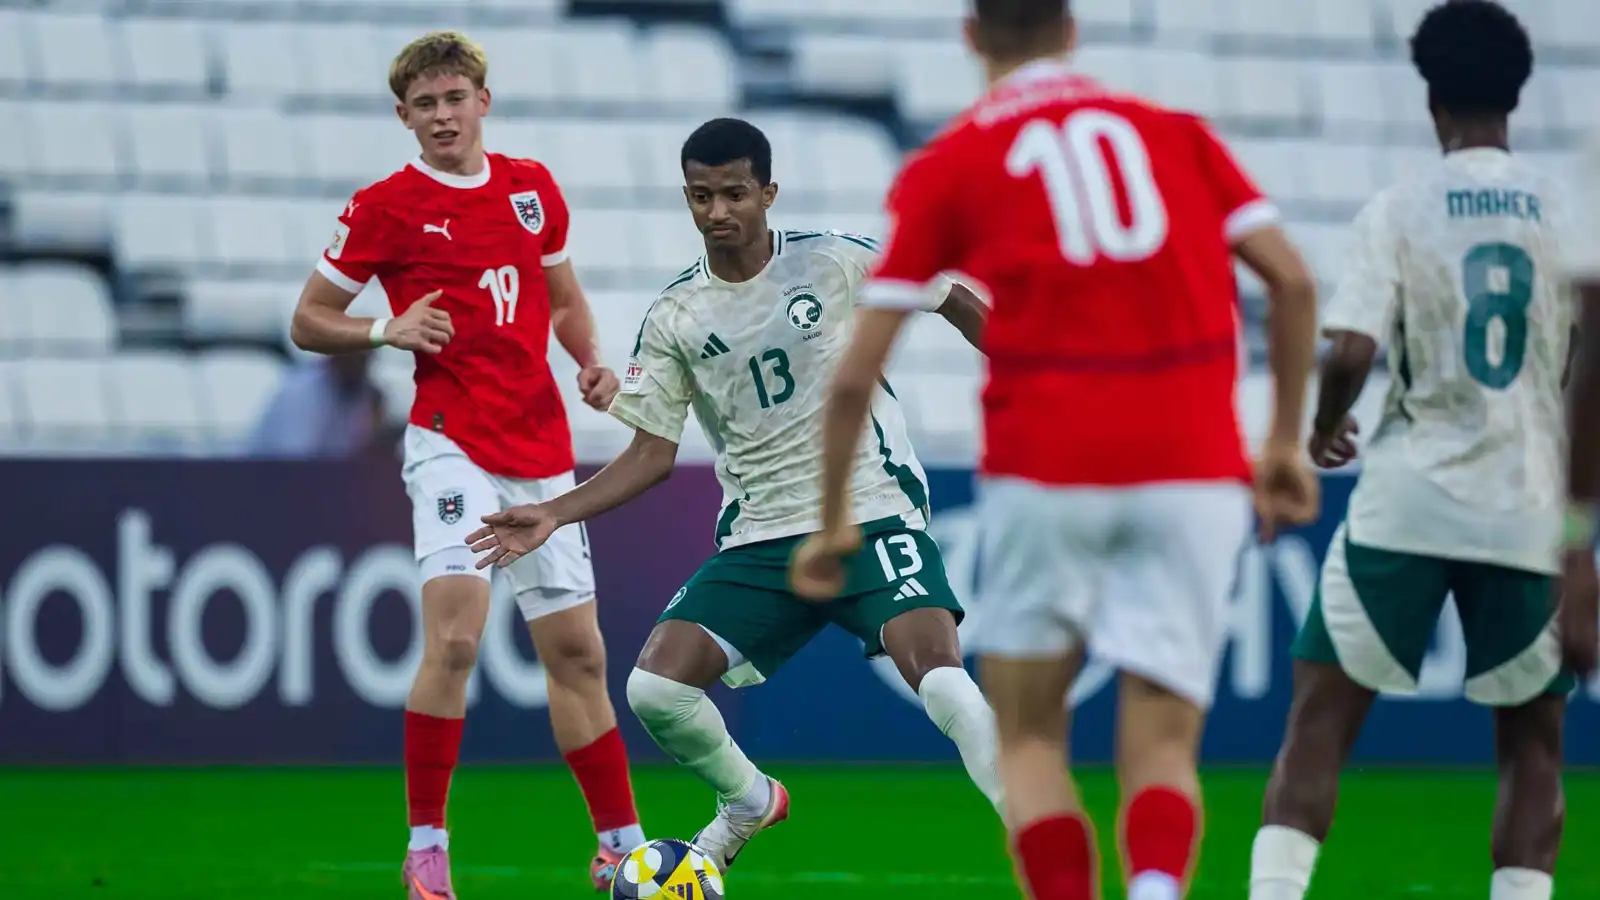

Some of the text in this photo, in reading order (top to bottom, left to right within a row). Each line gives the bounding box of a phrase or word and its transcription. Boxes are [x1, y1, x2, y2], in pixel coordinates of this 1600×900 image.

[1004, 106, 1169, 267] 10
[1447, 188, 1541, 221] MAHER
[478, 265, 520, 327] 19
[1463, 241, 1534, 391] 8
[802, 331, 823, 341] SAUDI
[748, 347, 796, 409] 13
[874, 533, 923, 583] 13
